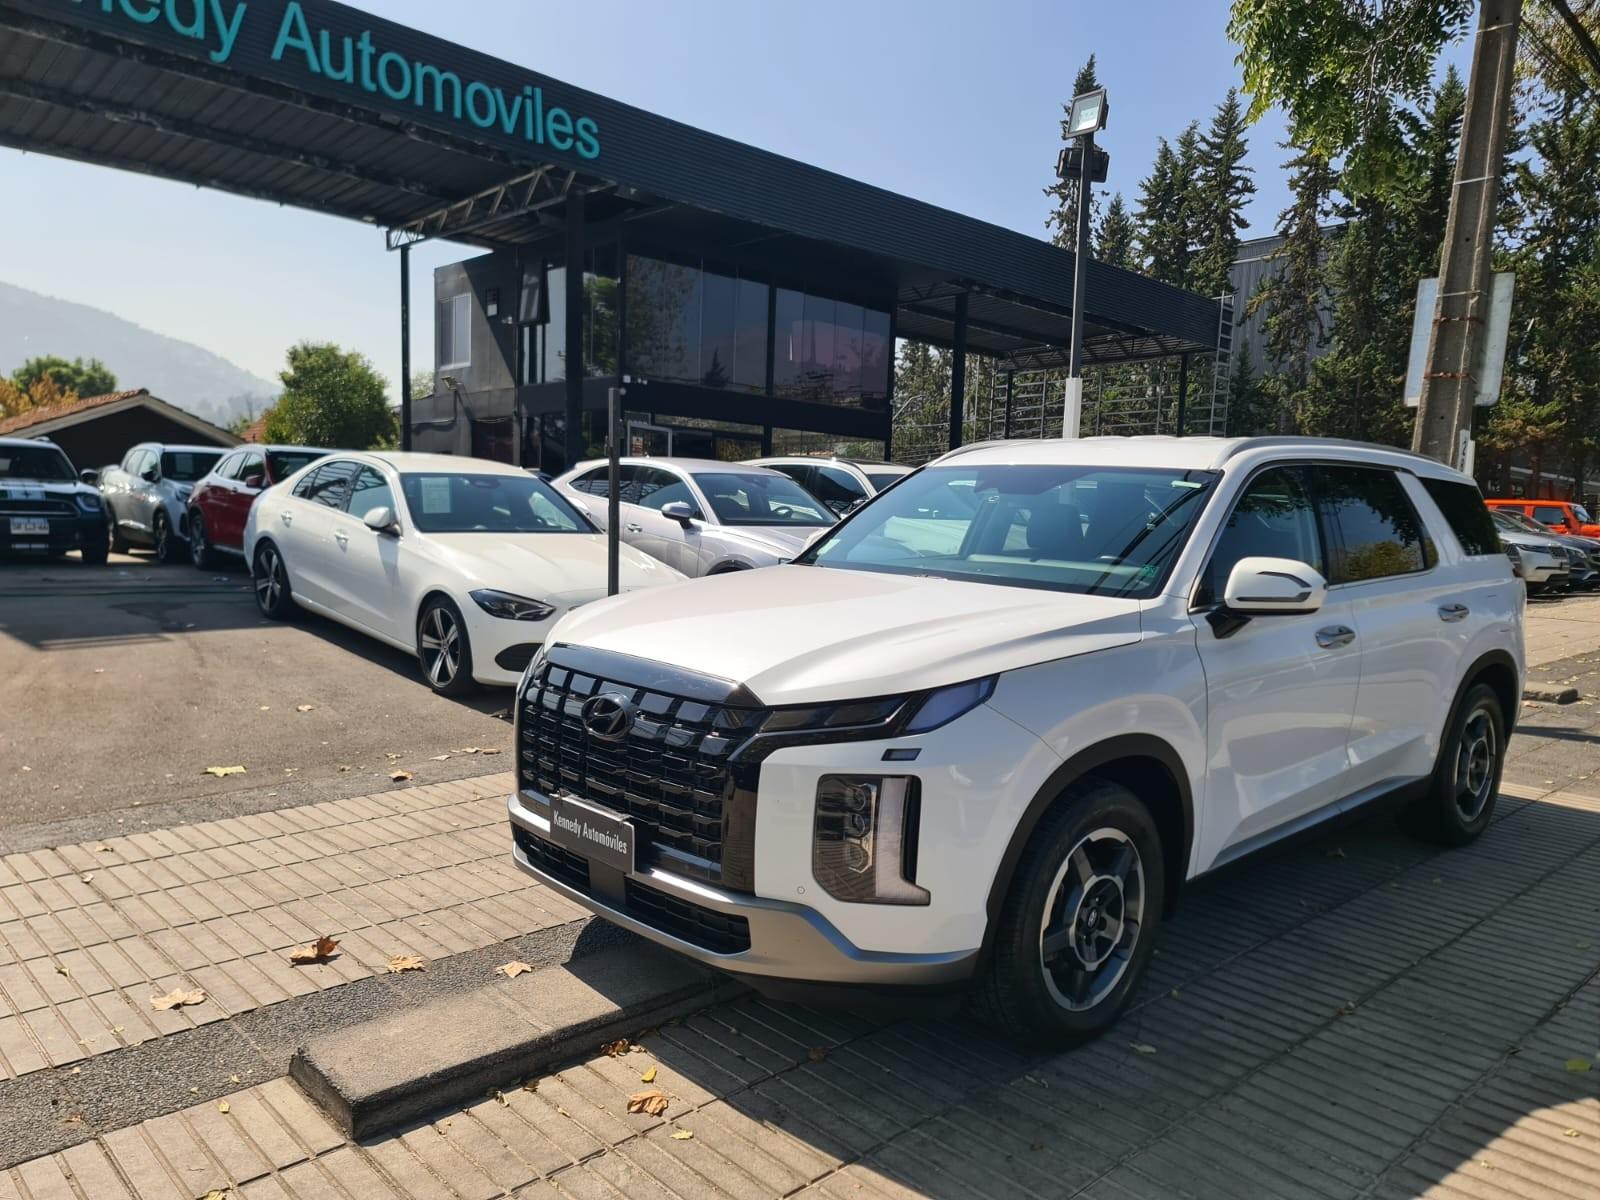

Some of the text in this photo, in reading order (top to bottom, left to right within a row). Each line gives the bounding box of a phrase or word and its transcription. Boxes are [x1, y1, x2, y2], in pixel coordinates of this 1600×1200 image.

[73, 0, 601, 160] edy Automoviles
[553, 810, 628, 854] Kennedy Automóviles
